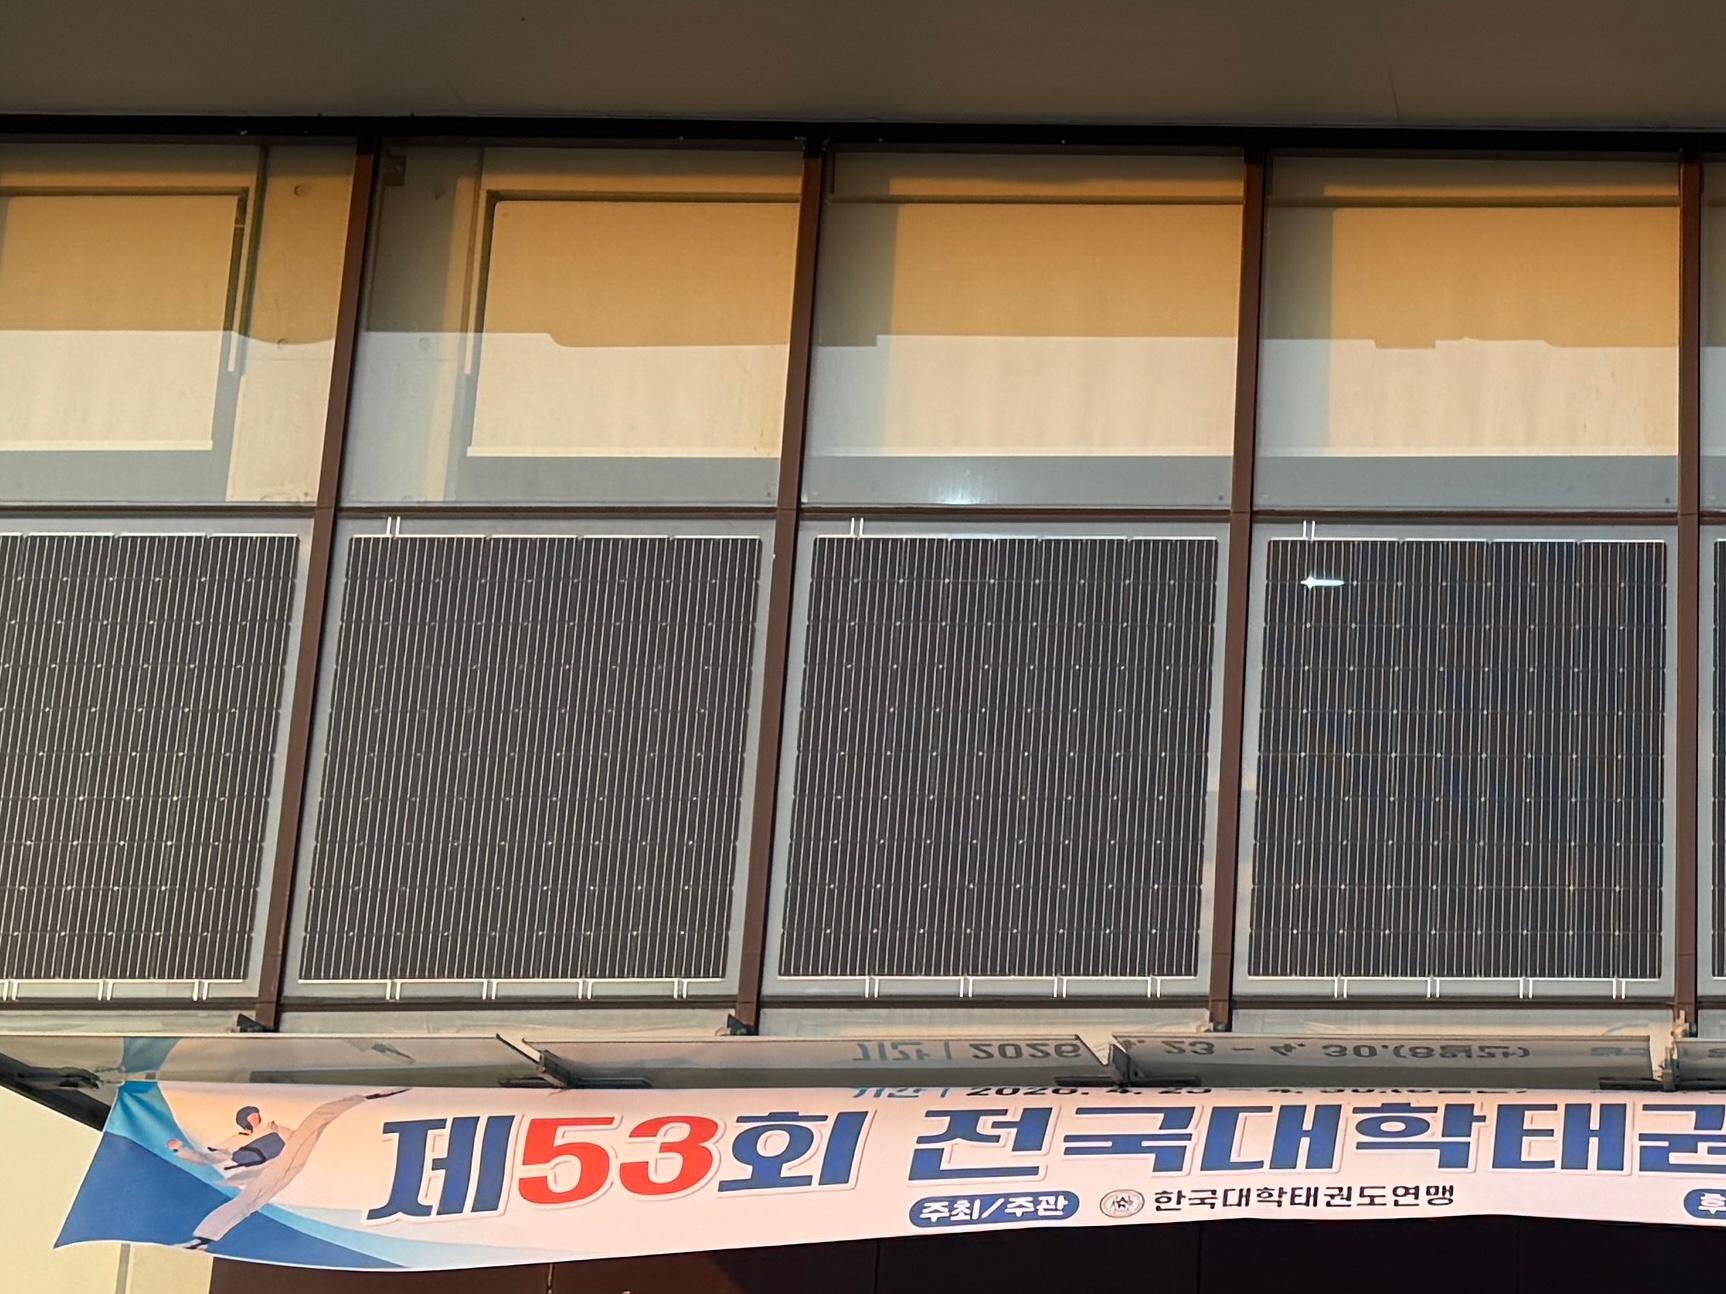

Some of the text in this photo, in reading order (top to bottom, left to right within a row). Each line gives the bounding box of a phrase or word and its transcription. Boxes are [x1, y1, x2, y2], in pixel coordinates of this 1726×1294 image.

[367, 1111, 868, 1220] 제53회
[920, 1194, 1069, 1223] 주최/주관
[1153, 1183, 1456, 1213] 한국대학태권도연맹
